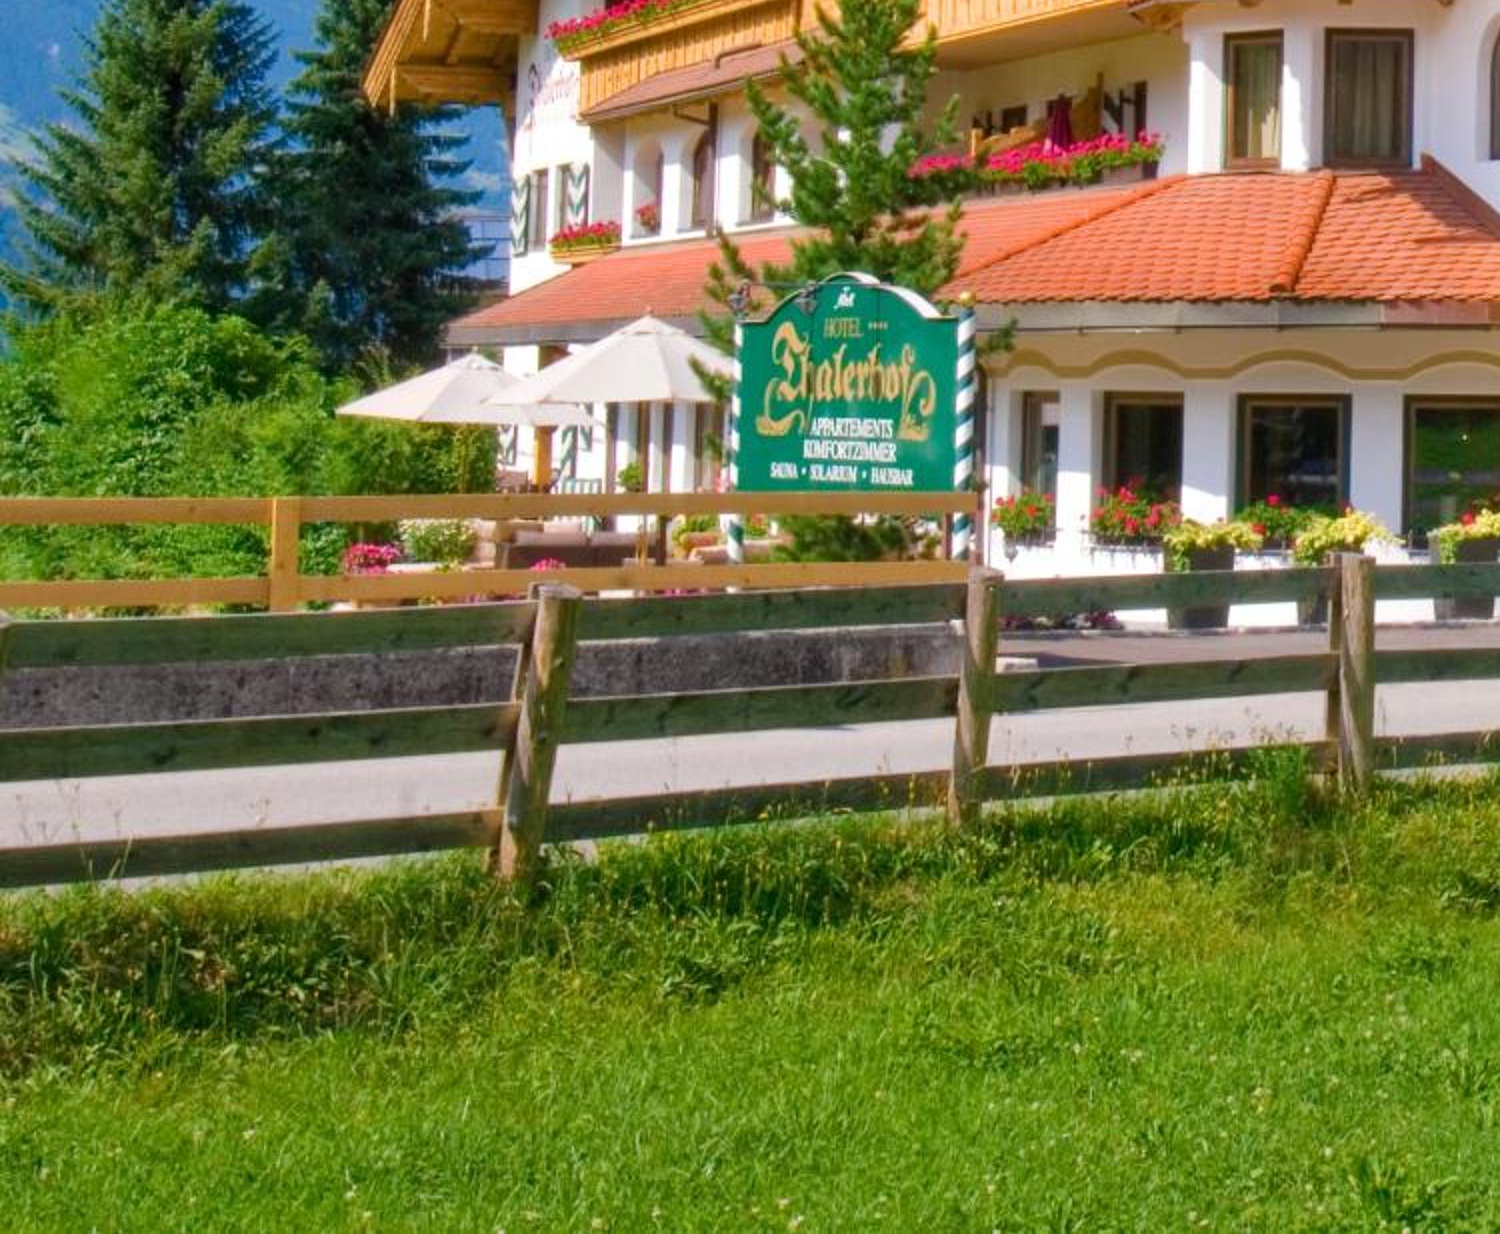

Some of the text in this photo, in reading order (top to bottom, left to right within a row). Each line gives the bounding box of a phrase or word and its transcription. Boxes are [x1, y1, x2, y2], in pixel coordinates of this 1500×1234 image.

[823, 317, 863, 338] HOTEL
[811, 417, 893, 438] APPARTEMENTS
[803, 440, 897, 463] KOMFORTZIMMER
[770, 462, 913, 485] SAUNA SOLARIUM HAUSBAR
